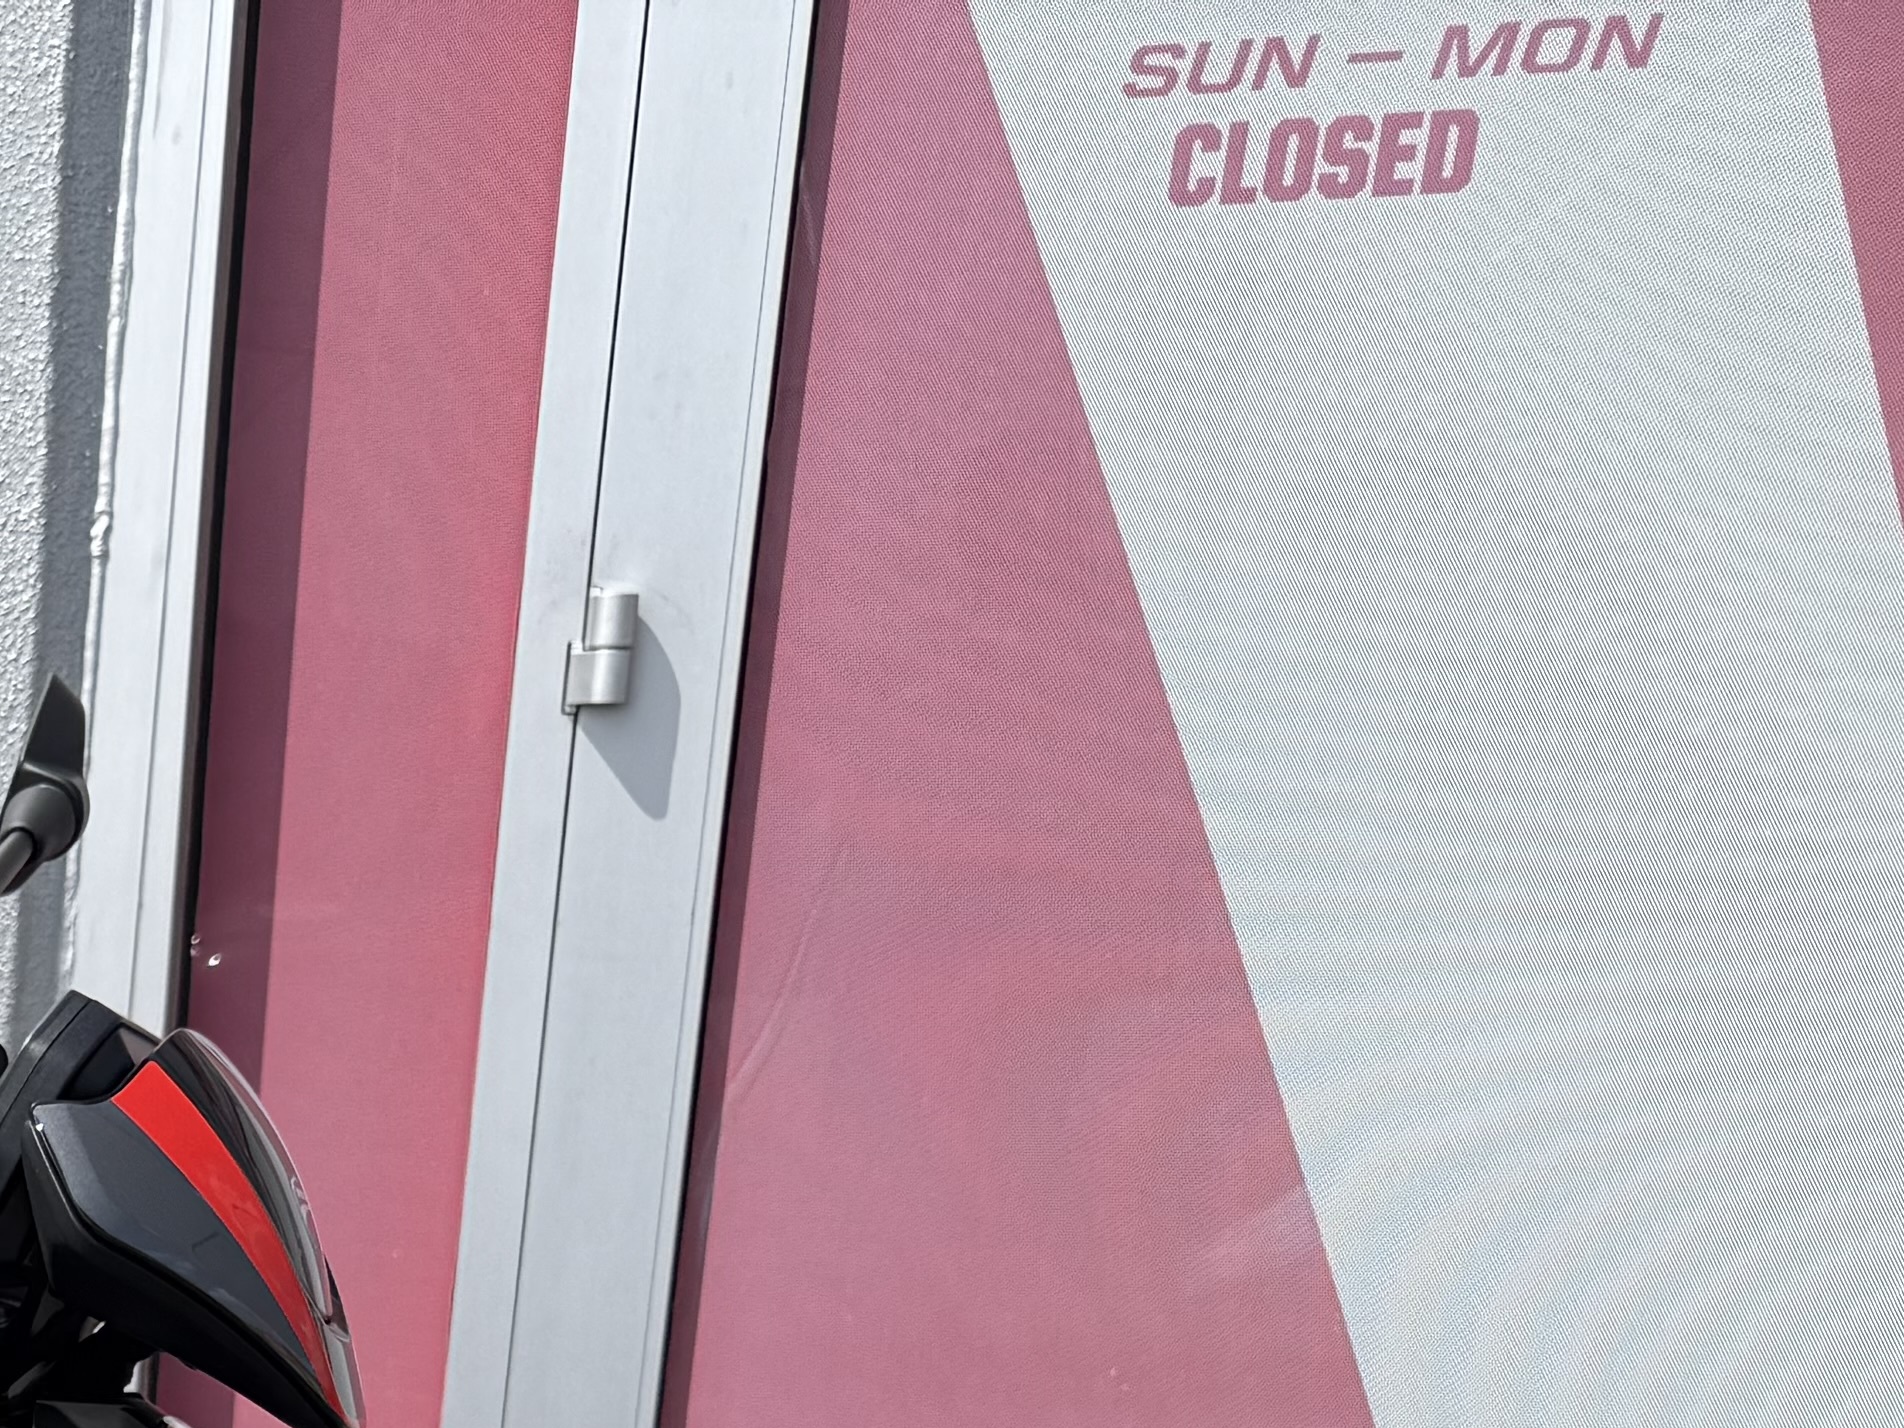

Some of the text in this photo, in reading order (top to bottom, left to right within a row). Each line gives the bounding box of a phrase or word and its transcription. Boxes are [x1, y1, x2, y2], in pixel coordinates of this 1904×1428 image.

[1123, 34, 1323, 99] SUN
[1431, 12, 1665, 81] MON
[1168, 107, 1482, 209] CLOSED
